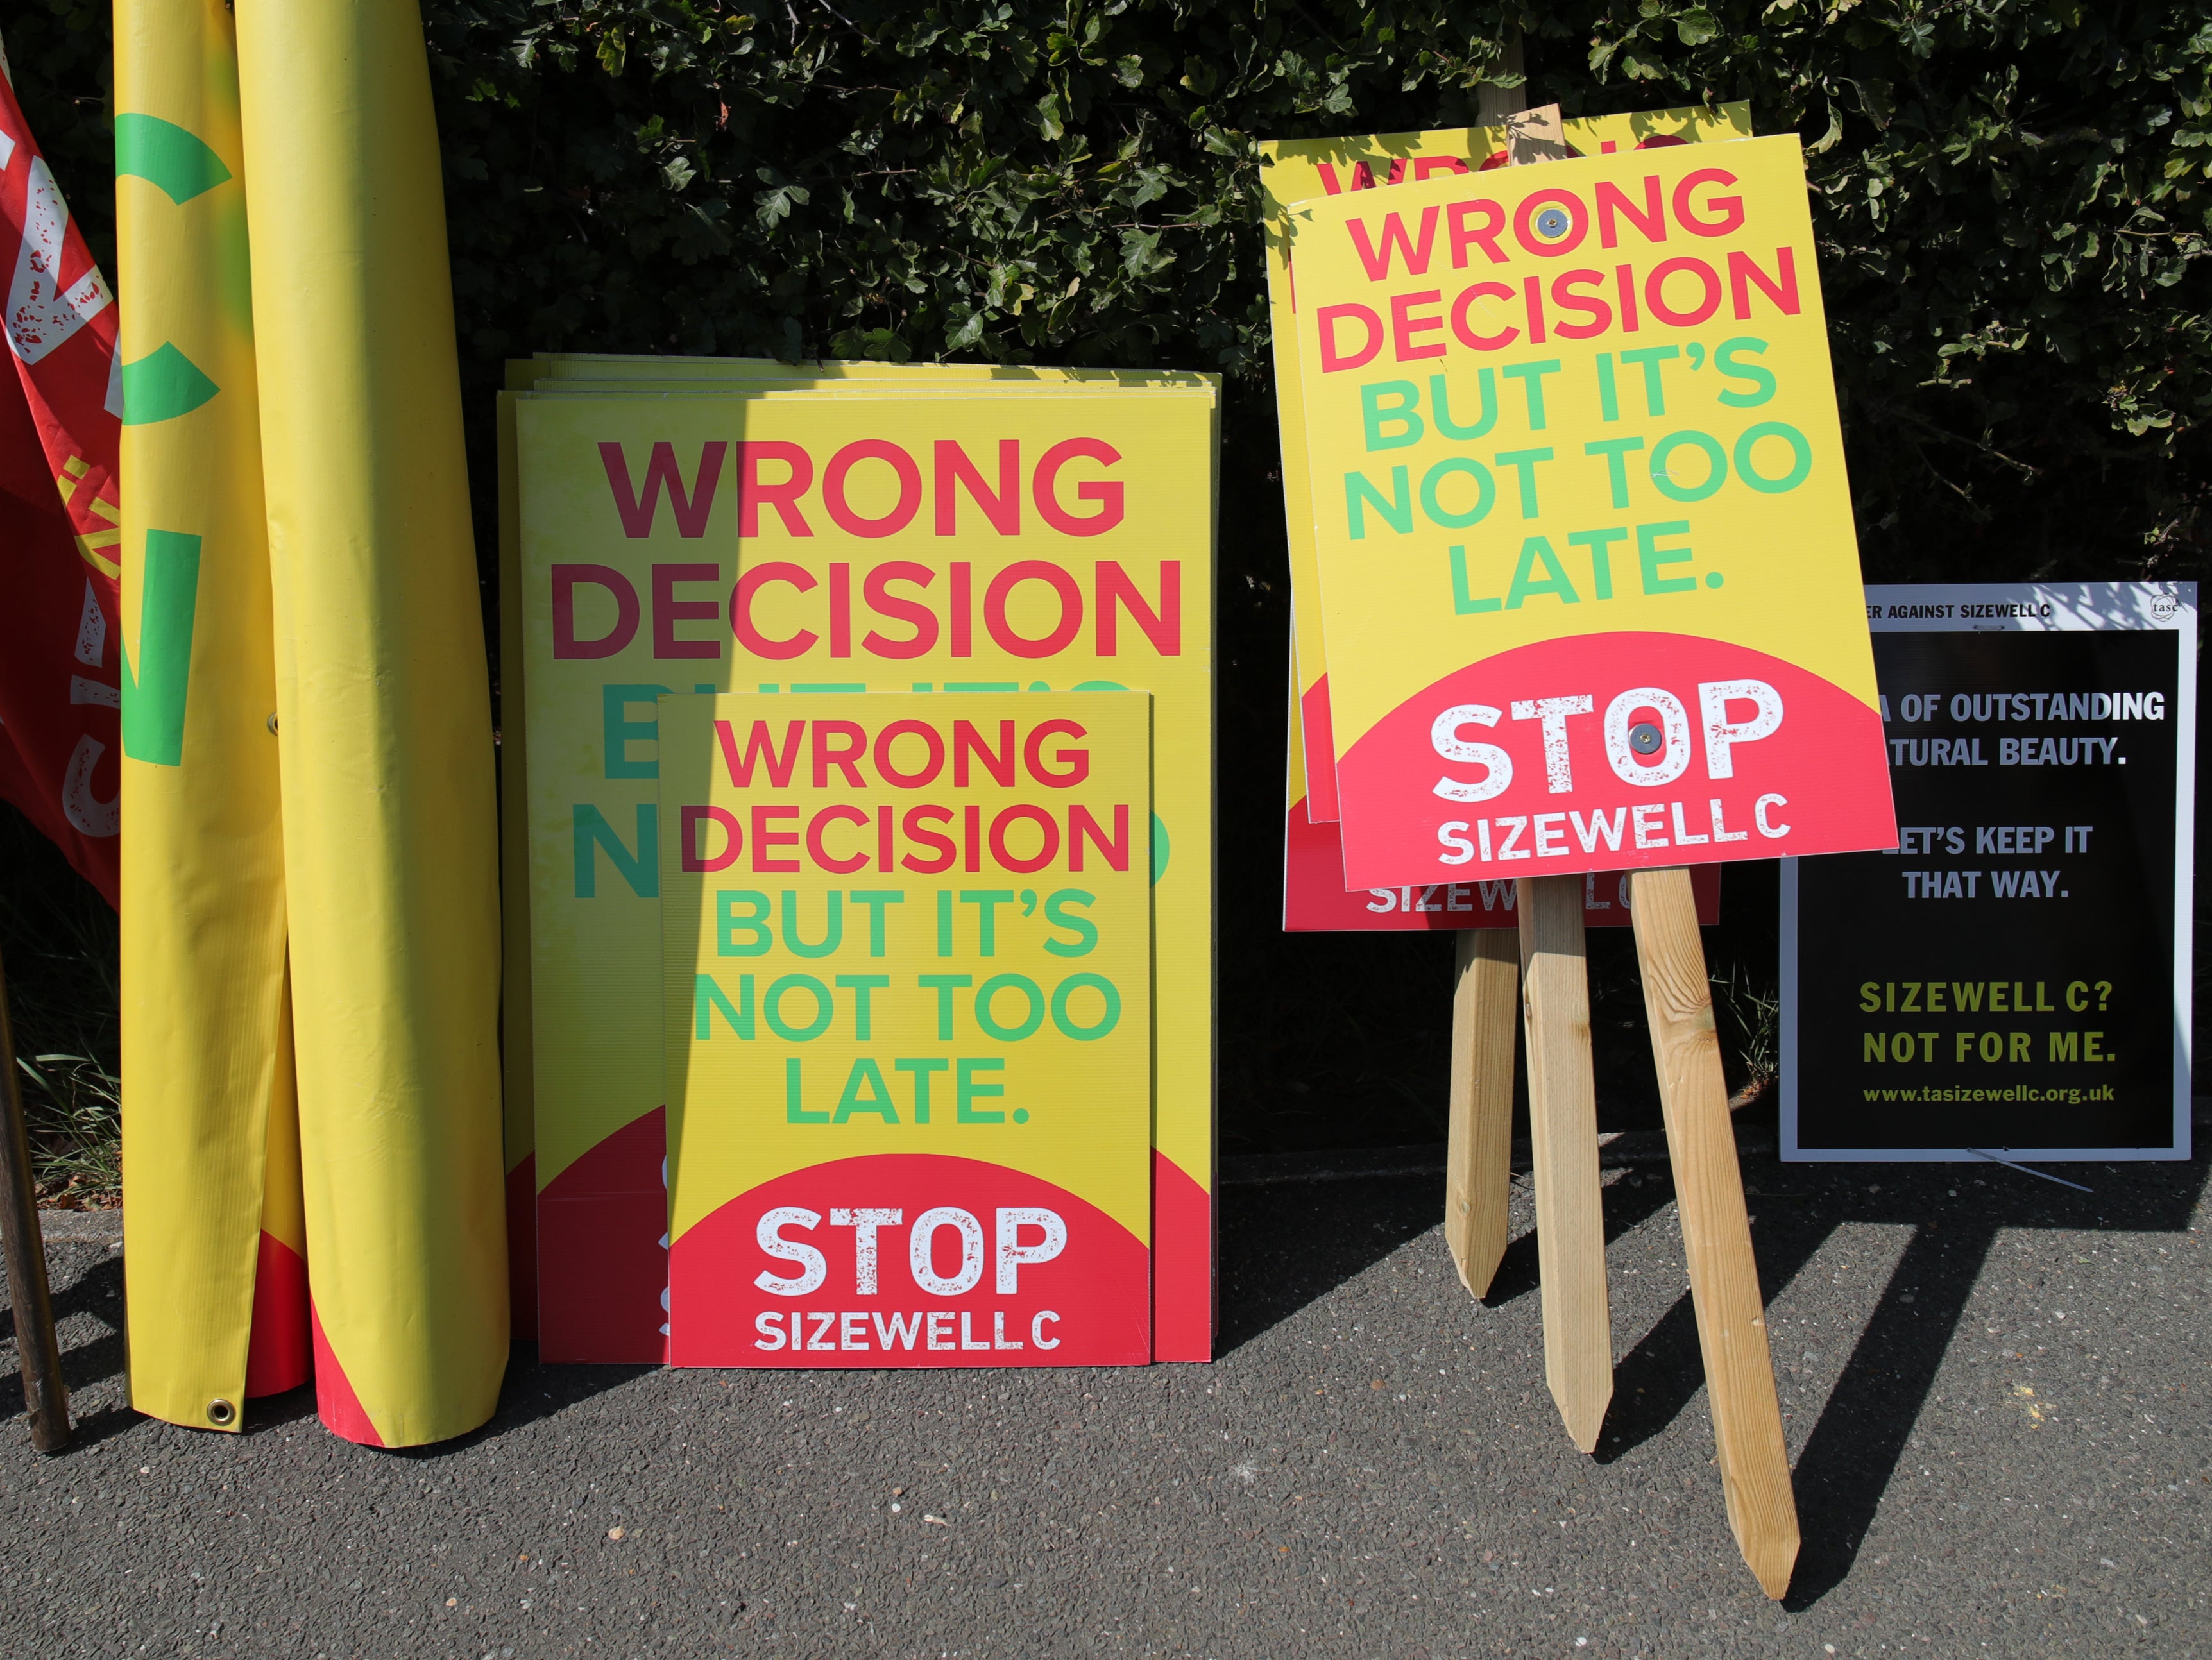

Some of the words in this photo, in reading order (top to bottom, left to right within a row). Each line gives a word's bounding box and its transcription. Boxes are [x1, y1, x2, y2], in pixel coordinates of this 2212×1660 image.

[1346, 168, 1745, 282] WRONG
[1317, 246, 1800, 373] DECISION
[1361, 359, 1561, 452] BUT
[598, 437, 1125, 538] WRONG
[1345, 447, 1554, 540] NOT
[1585, 421, 1812, 509] TOO
[1449, 520, 1724, 615] LATE.
[551, 560, 1180, 660] DECISION
[1888, 605, 1955, 618] AGAINST
[1960, 604, 2036, 618] SIZEWELL
[2040, 604, 2050, 617] C
[2153, 604, 2179, 612] tasc
[1431, 679, 1784, 802] STOP
[1900, 693, 1941, 722] OF
[1950, 690, 2166, 722] OUTSTANDING
[714, 719, 1089, 789] WRONG
[1887, 738, 1989, 766] TURAL
[1999, 736, 2127, 765] BEAUTY.
[681, 804, 1130, 874] DECISION
[1437, 799, 1748, 865] SIZEWELL
[1755, 793, 1791, 839] C
[1976, 826, 2055, 854] KEEP
[2065, 826, 2094, 854] IT
[1901, 870, 1982, 899] THAT
[1990, 870, 2070, 898] WAY.
[717, 890, 905, 958] BUT
[695, 973, 890, 1042] NOT
[919, 972, 1122, 1042] TOO
[1859, 981, 2055, 1012] SIZEWELL
[2066, 981, 2113, 1012] C?
[1863, 1031, 1939, 1063] NOT
[1955, 1031, 2031, 1063] FOR
[2049, 1031, 2116, 1062] ME.
[786, 1058, 1030, 1124] LATE.
[1863, 1084, 2114, 1105] www.tasizewellc.org.uk
[754, 1206, 1068, 1296] STOP
[754, 1310, 1025, 1351] SIZEWELL
[1032, 1310, 1062, 1350] C
